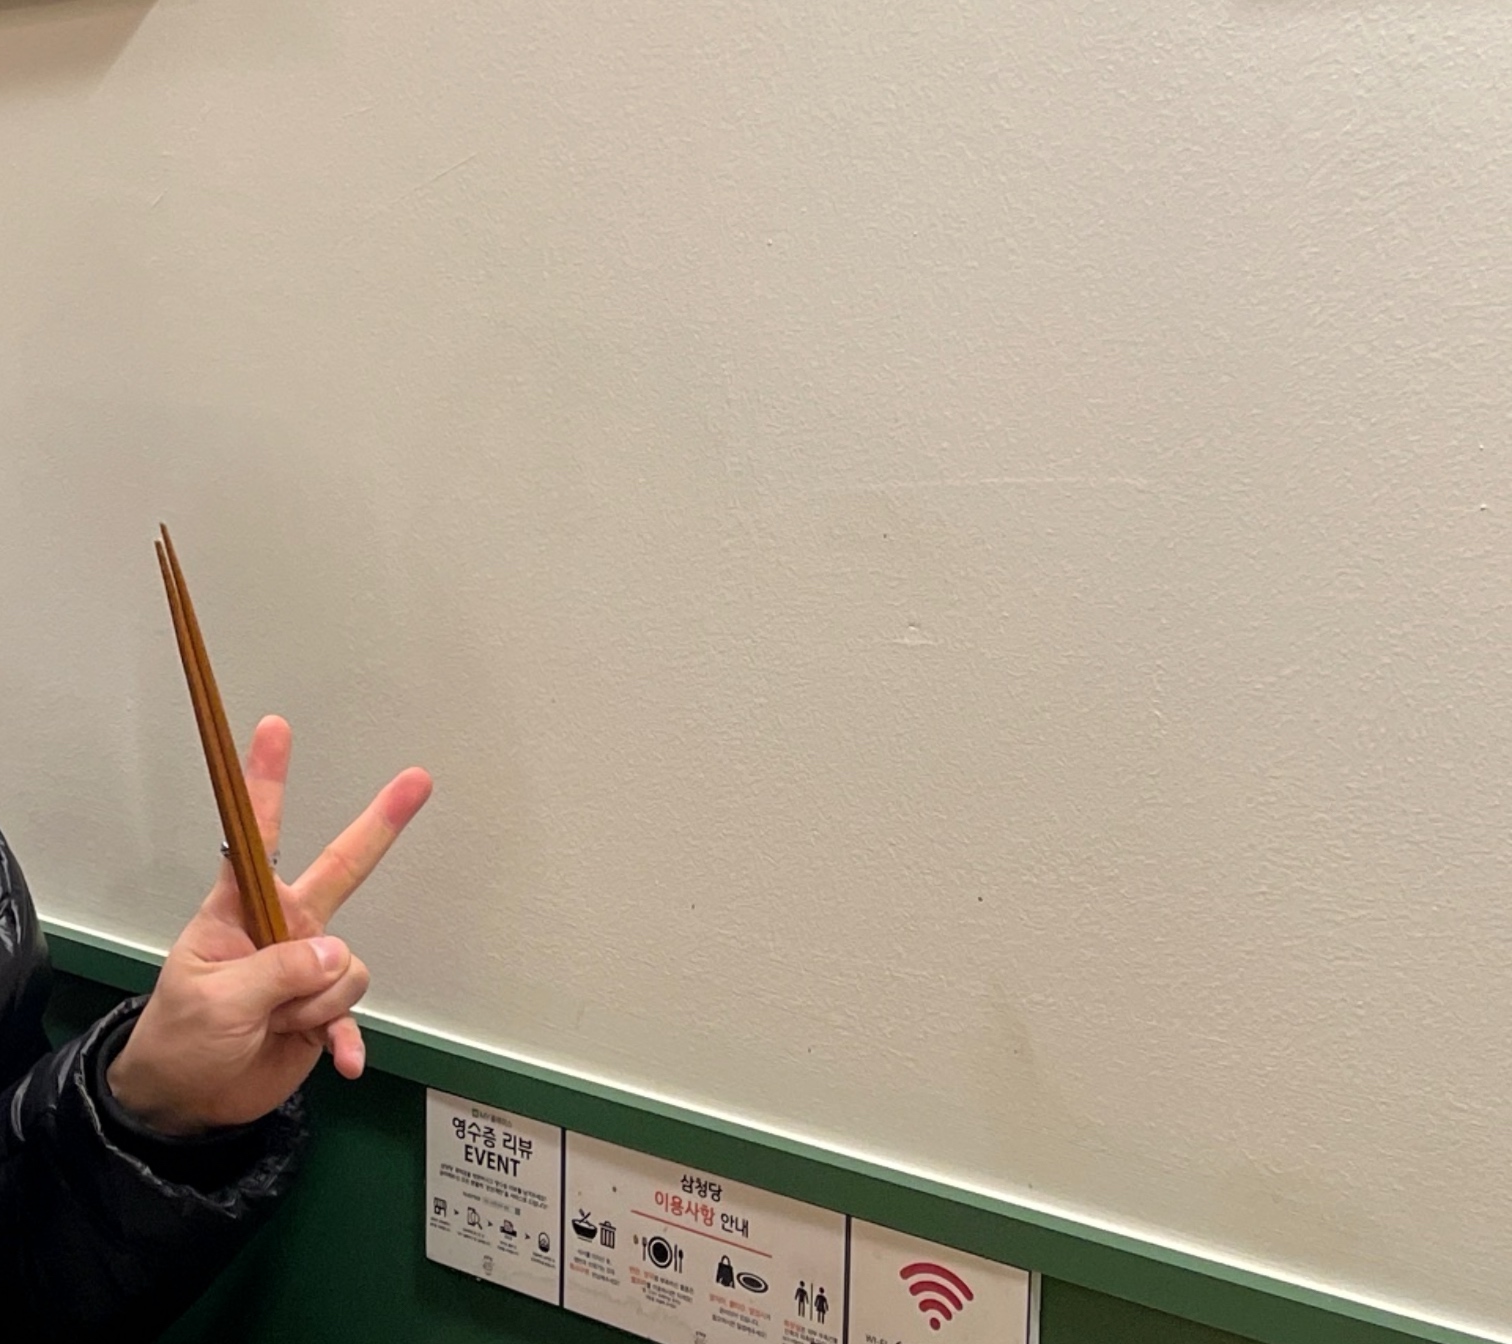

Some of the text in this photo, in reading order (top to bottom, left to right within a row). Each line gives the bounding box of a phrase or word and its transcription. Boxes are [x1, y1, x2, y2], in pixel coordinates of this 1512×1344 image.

[452, 1117, 496, 1148] 영수증
[502, 1132, 533, 1160] 리뷰
[464, 1144, 521, 1177] EVENT
[680, 1174, 722, 1202] 삼청당
[654, 1191, 749, 1238] 이용사항 안내
